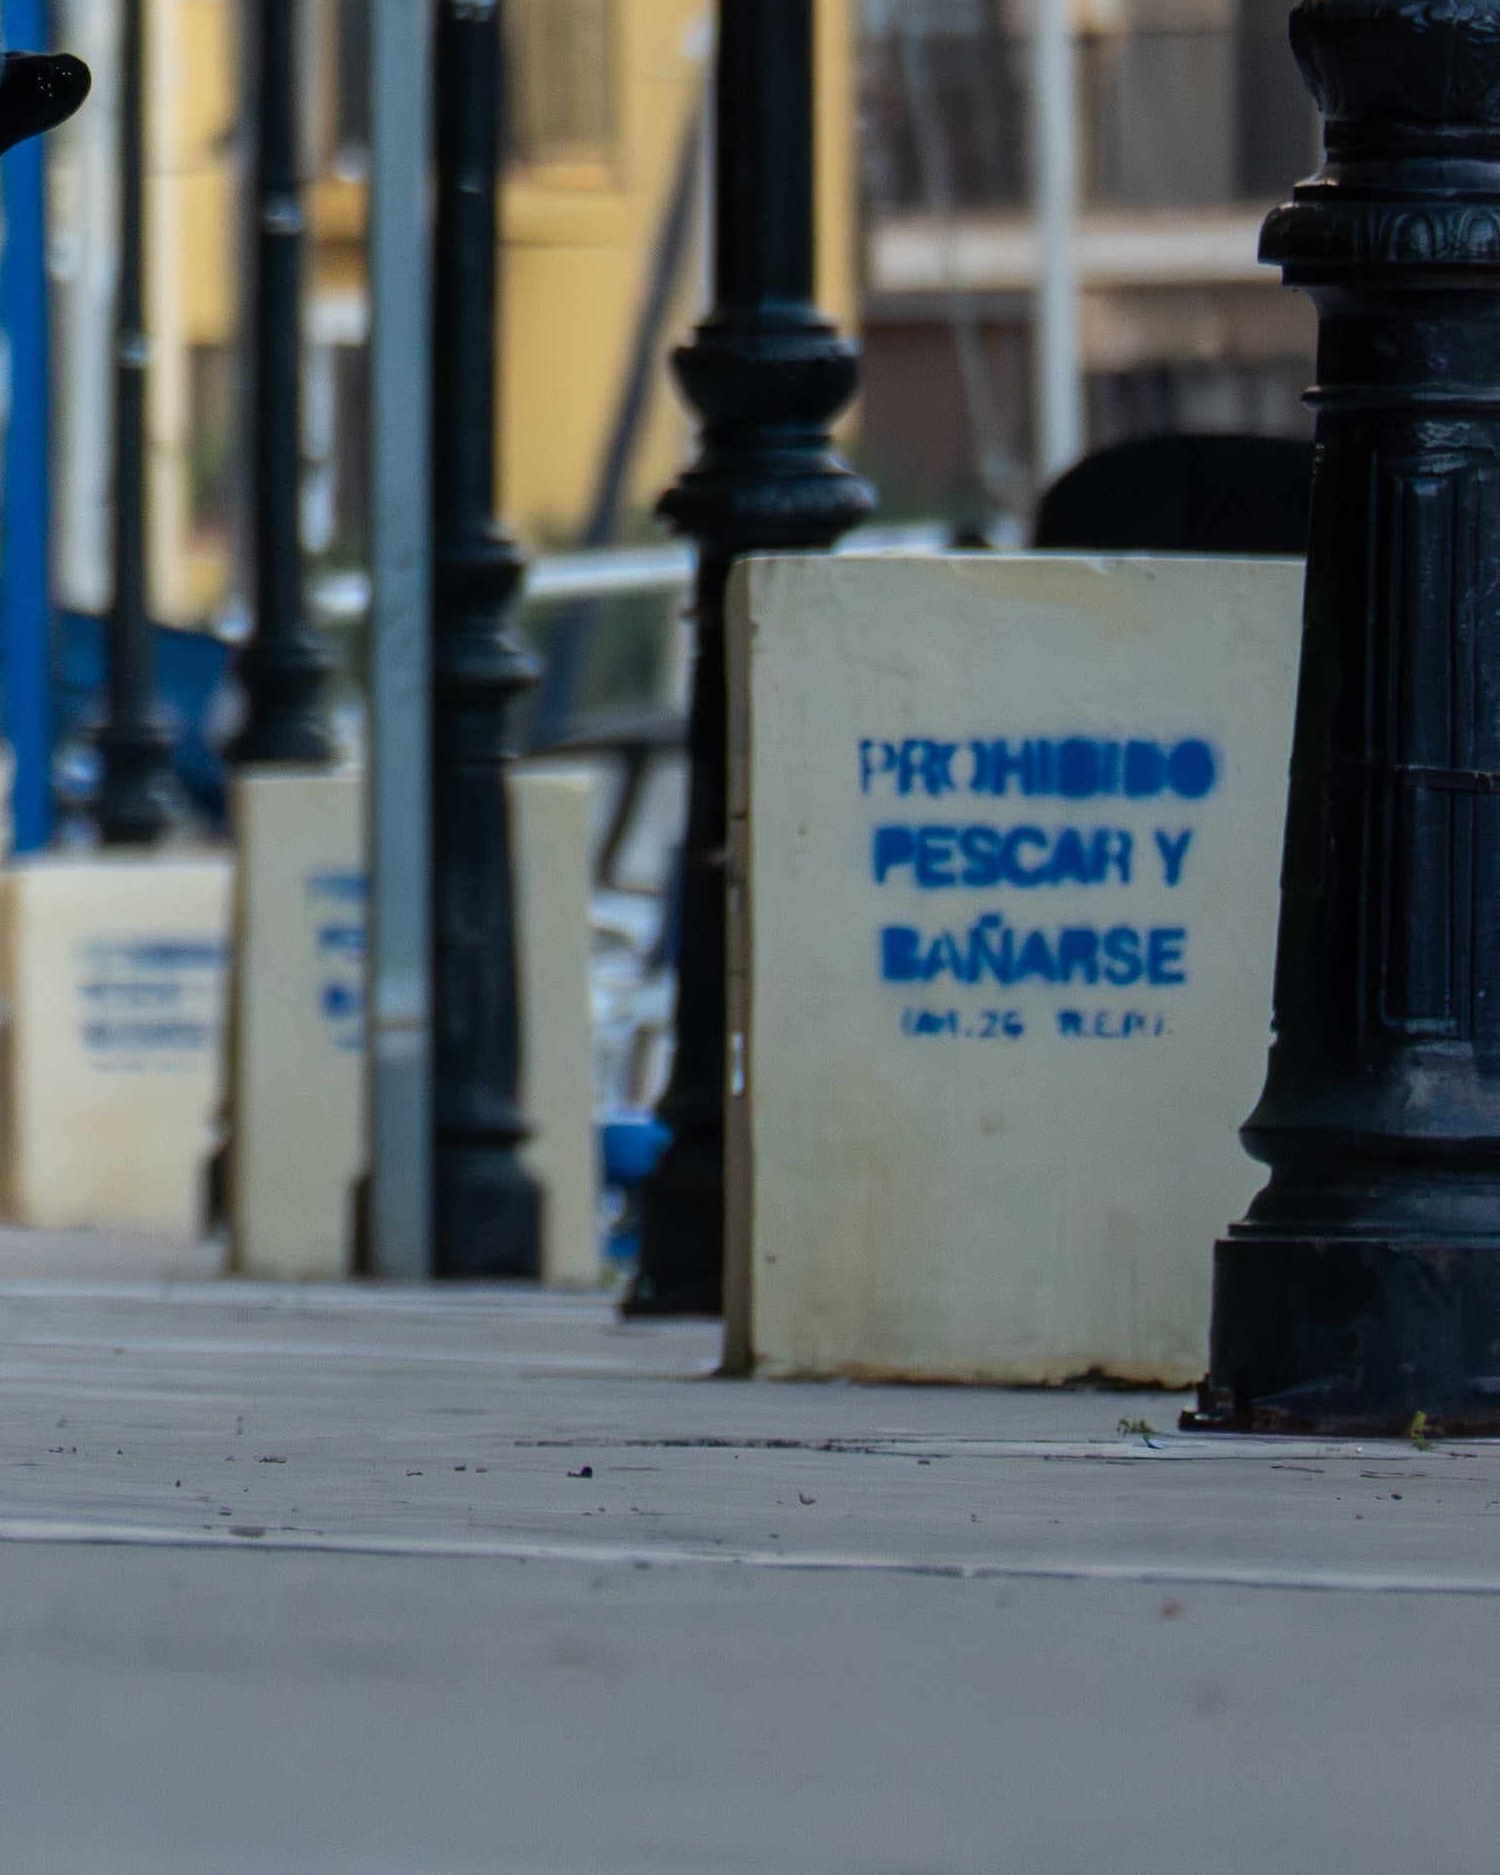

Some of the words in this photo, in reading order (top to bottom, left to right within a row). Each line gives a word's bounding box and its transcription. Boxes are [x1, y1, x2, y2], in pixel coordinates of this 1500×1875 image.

[859, 734, 1218, 802] PROHIBIDO
[871, 823, 1134, 891] PESCAR
[1152, 827, 1193, 888] Y
[879, 912, 1188, 990] BAÑARSE
